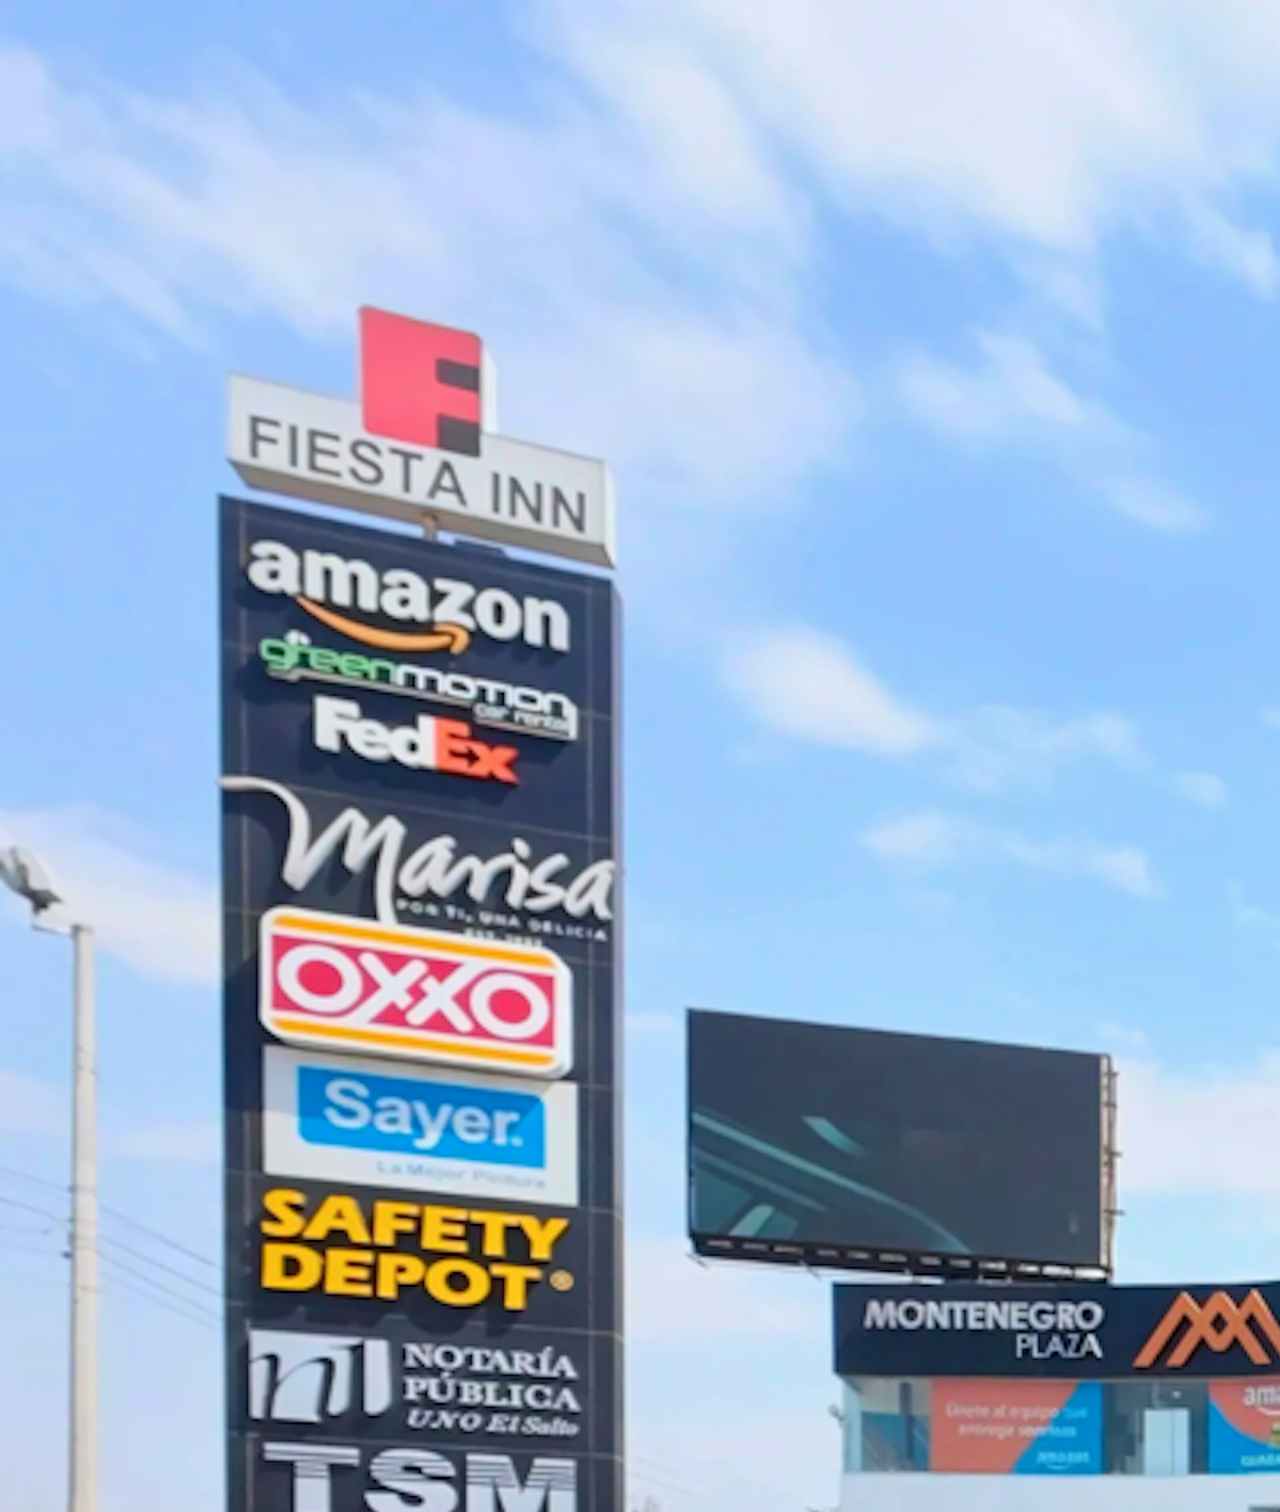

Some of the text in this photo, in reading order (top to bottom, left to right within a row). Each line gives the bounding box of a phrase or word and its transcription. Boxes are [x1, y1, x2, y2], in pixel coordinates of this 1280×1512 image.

[248, 414, 587, 534] FIESTA INN
[247, 540, 571, 652] amazon
[313, 696, 519, 785] FedEx
[217, 775, 616, 927] Marisa
[277, 944, 550, 1040] OXXO
[259, 1188, 570, 1261] SAFETY
[260, 1243, 543, 1311] DEPOT
[863, 1299, 1103, 1331] MONTENEGRO
[1014, 1332, 1103, 1359] PLAZA
[402, 1342, 579, 1380] NOTARÍA
[402, 1374, 581, 1412] PÚBLICA
